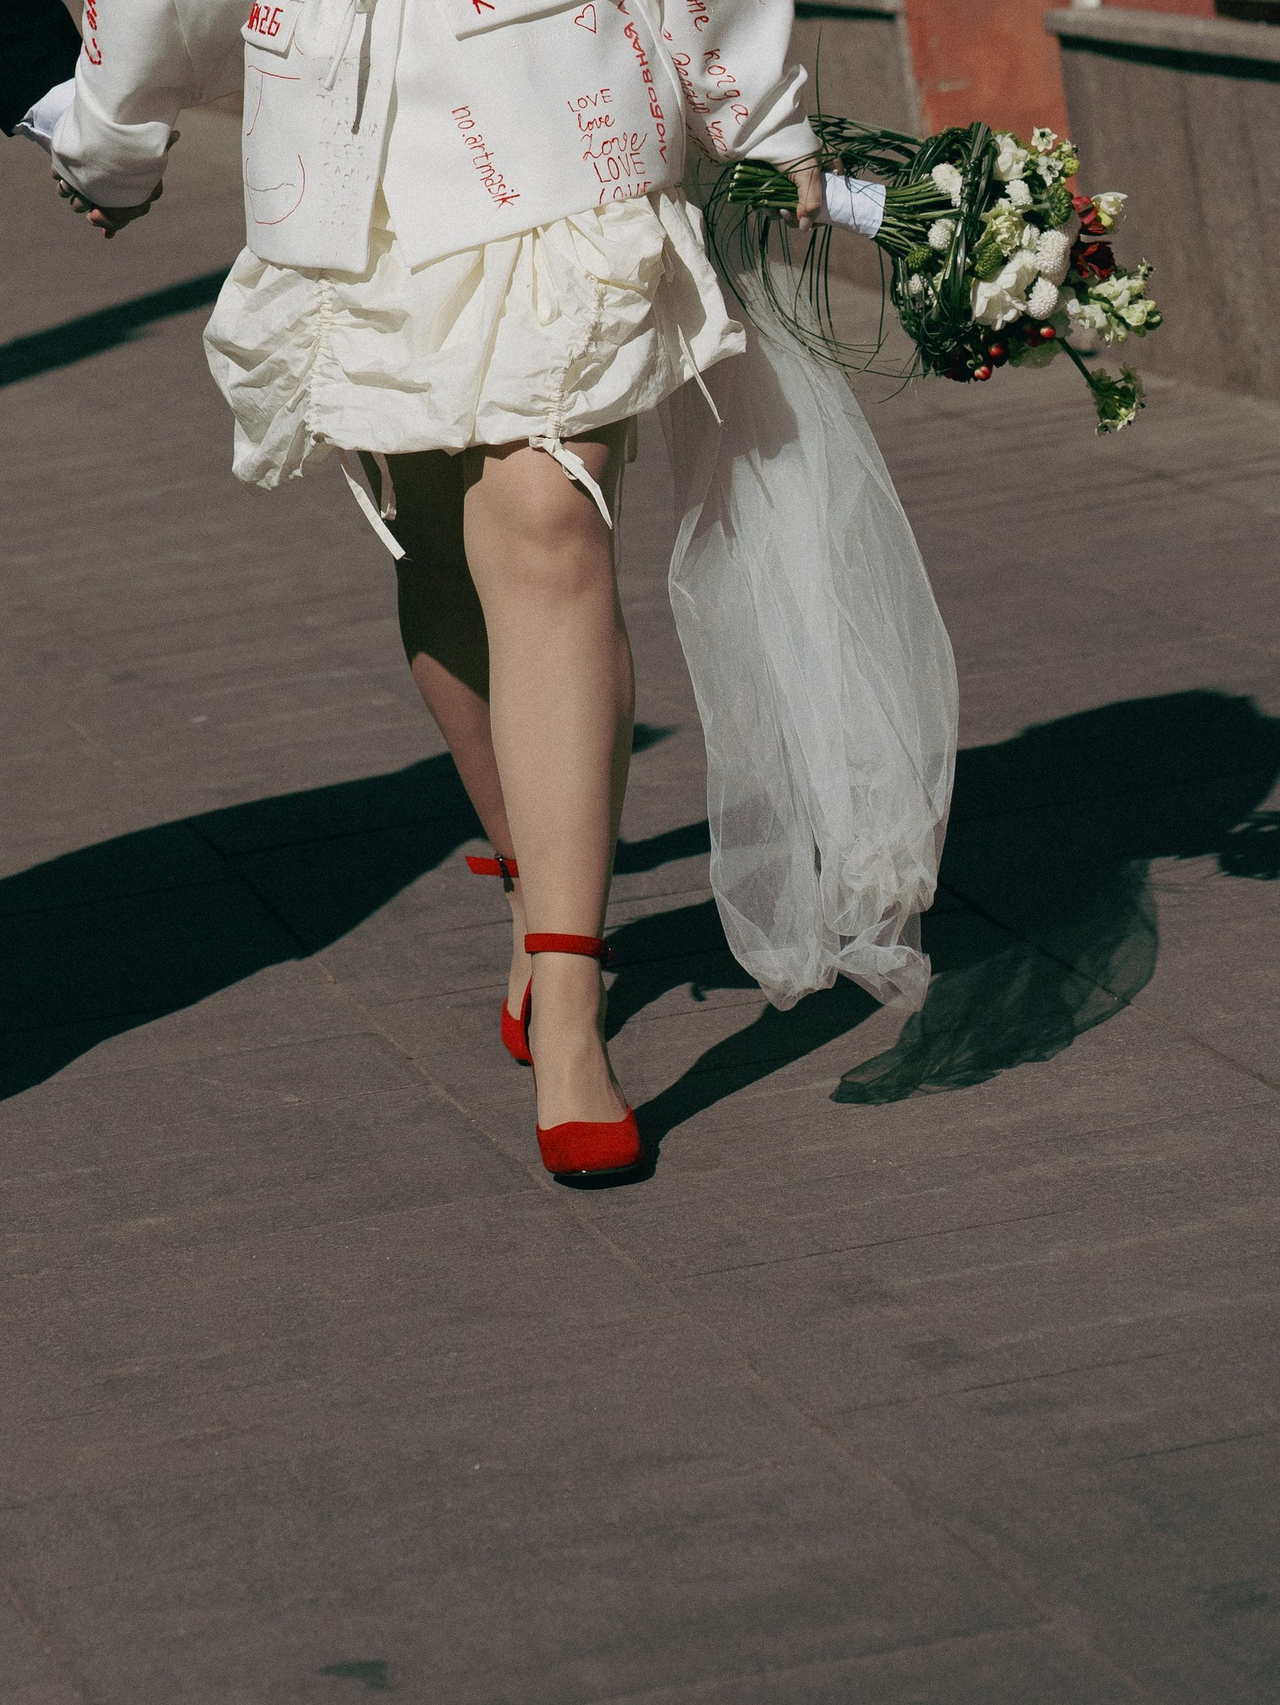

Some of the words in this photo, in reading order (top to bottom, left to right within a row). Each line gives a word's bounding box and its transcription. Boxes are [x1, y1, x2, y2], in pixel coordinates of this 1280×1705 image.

[567, 88, 614, 113] LOVE
[623, 21, 668, 163] ЛЮБОВНАЯ
[703, 48, 750, 128] когда
[577, 113, 616, 132] love
[593, 152, 646, 183] LOVE
